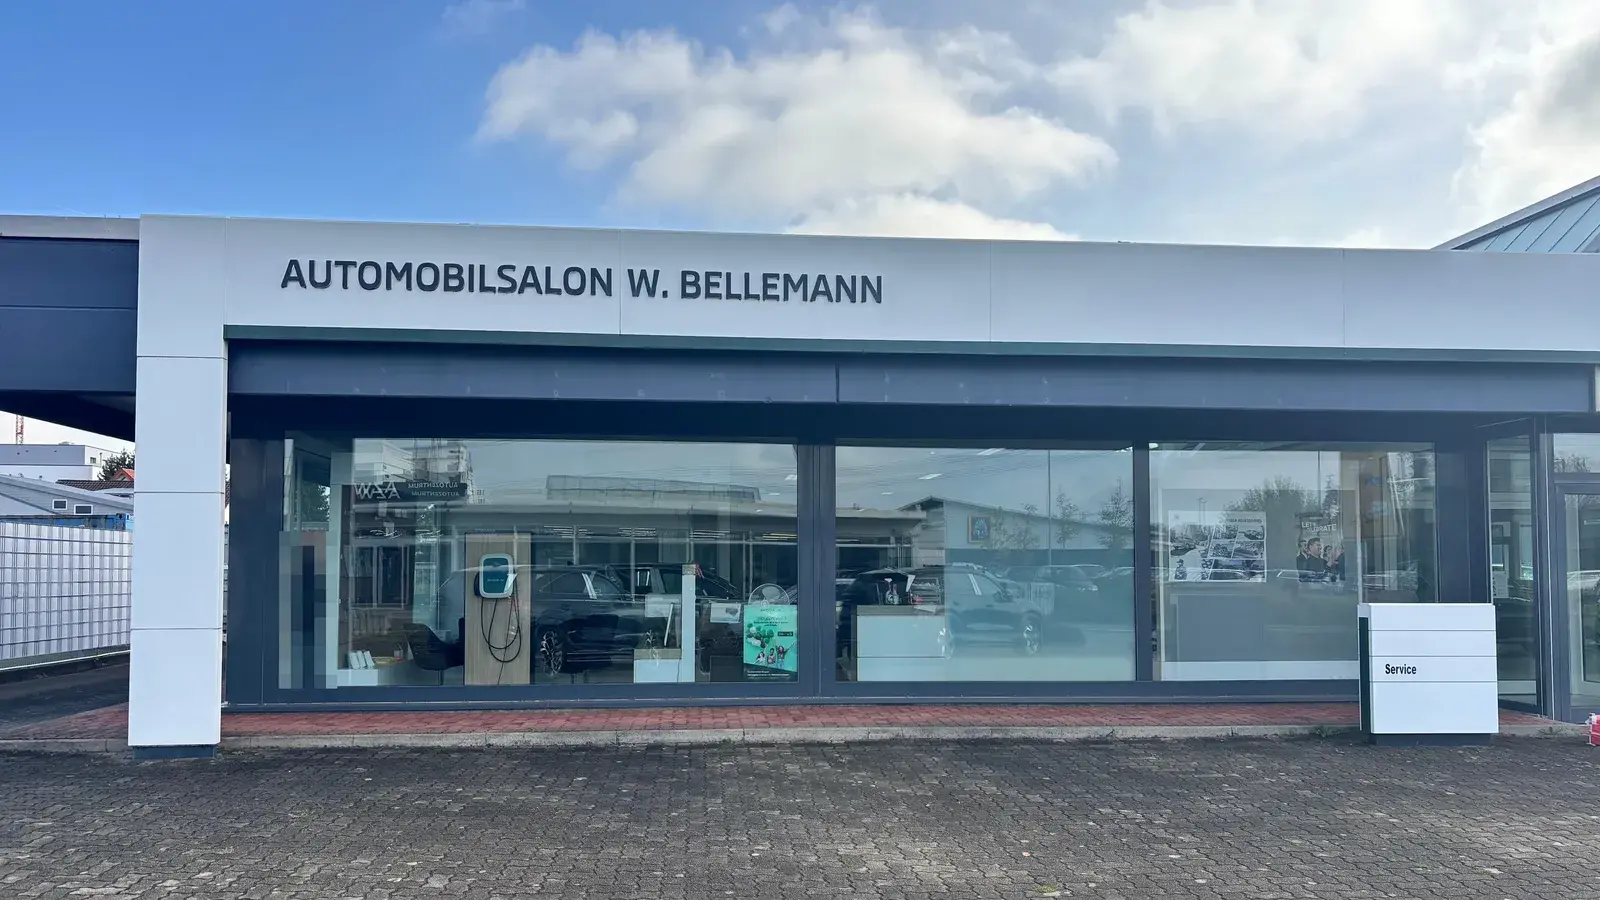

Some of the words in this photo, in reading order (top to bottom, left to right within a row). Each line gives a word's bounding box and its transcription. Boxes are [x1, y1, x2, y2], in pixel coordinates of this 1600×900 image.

[281, 259, 613, 297] AUTOMOBILSALON
[627, 268, 669, 299] W.
[680, 269, 882, 304] BELLEMANN
[1385, 663, 1417, 675] Service
